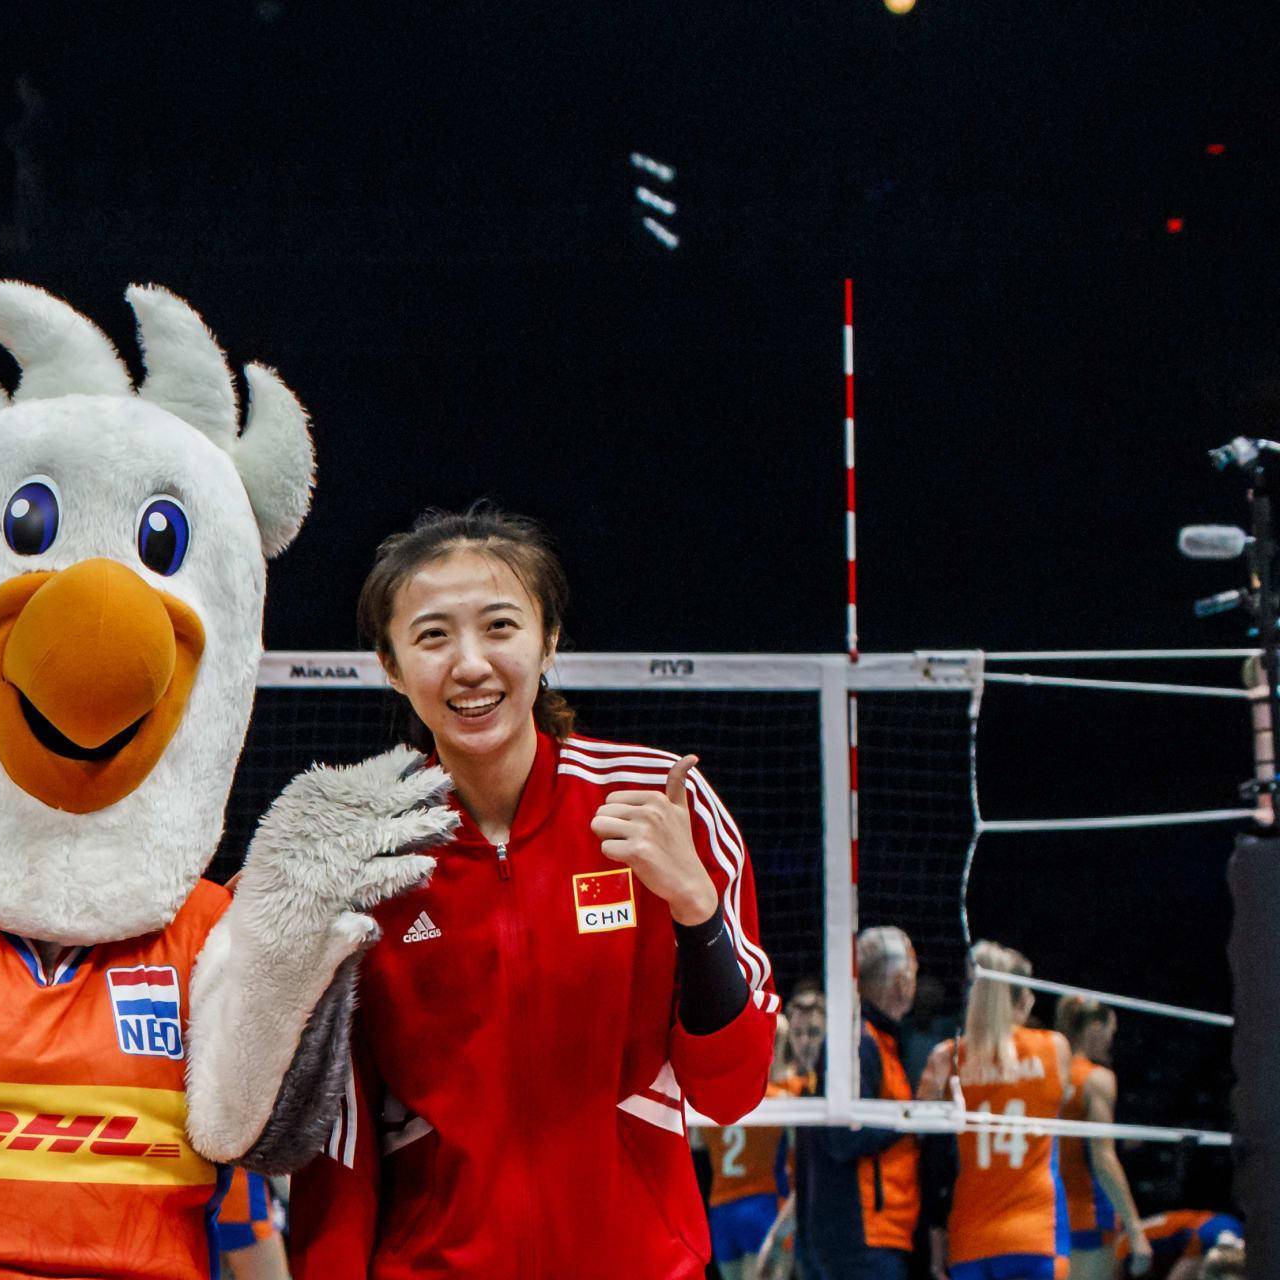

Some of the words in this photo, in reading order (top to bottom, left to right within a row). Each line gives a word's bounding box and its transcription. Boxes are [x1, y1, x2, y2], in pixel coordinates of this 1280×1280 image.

[585, 907, 630, 927] CHN
[402, 926, 441, 944] adidas
[974, 1099, 1029, 1171] 14
